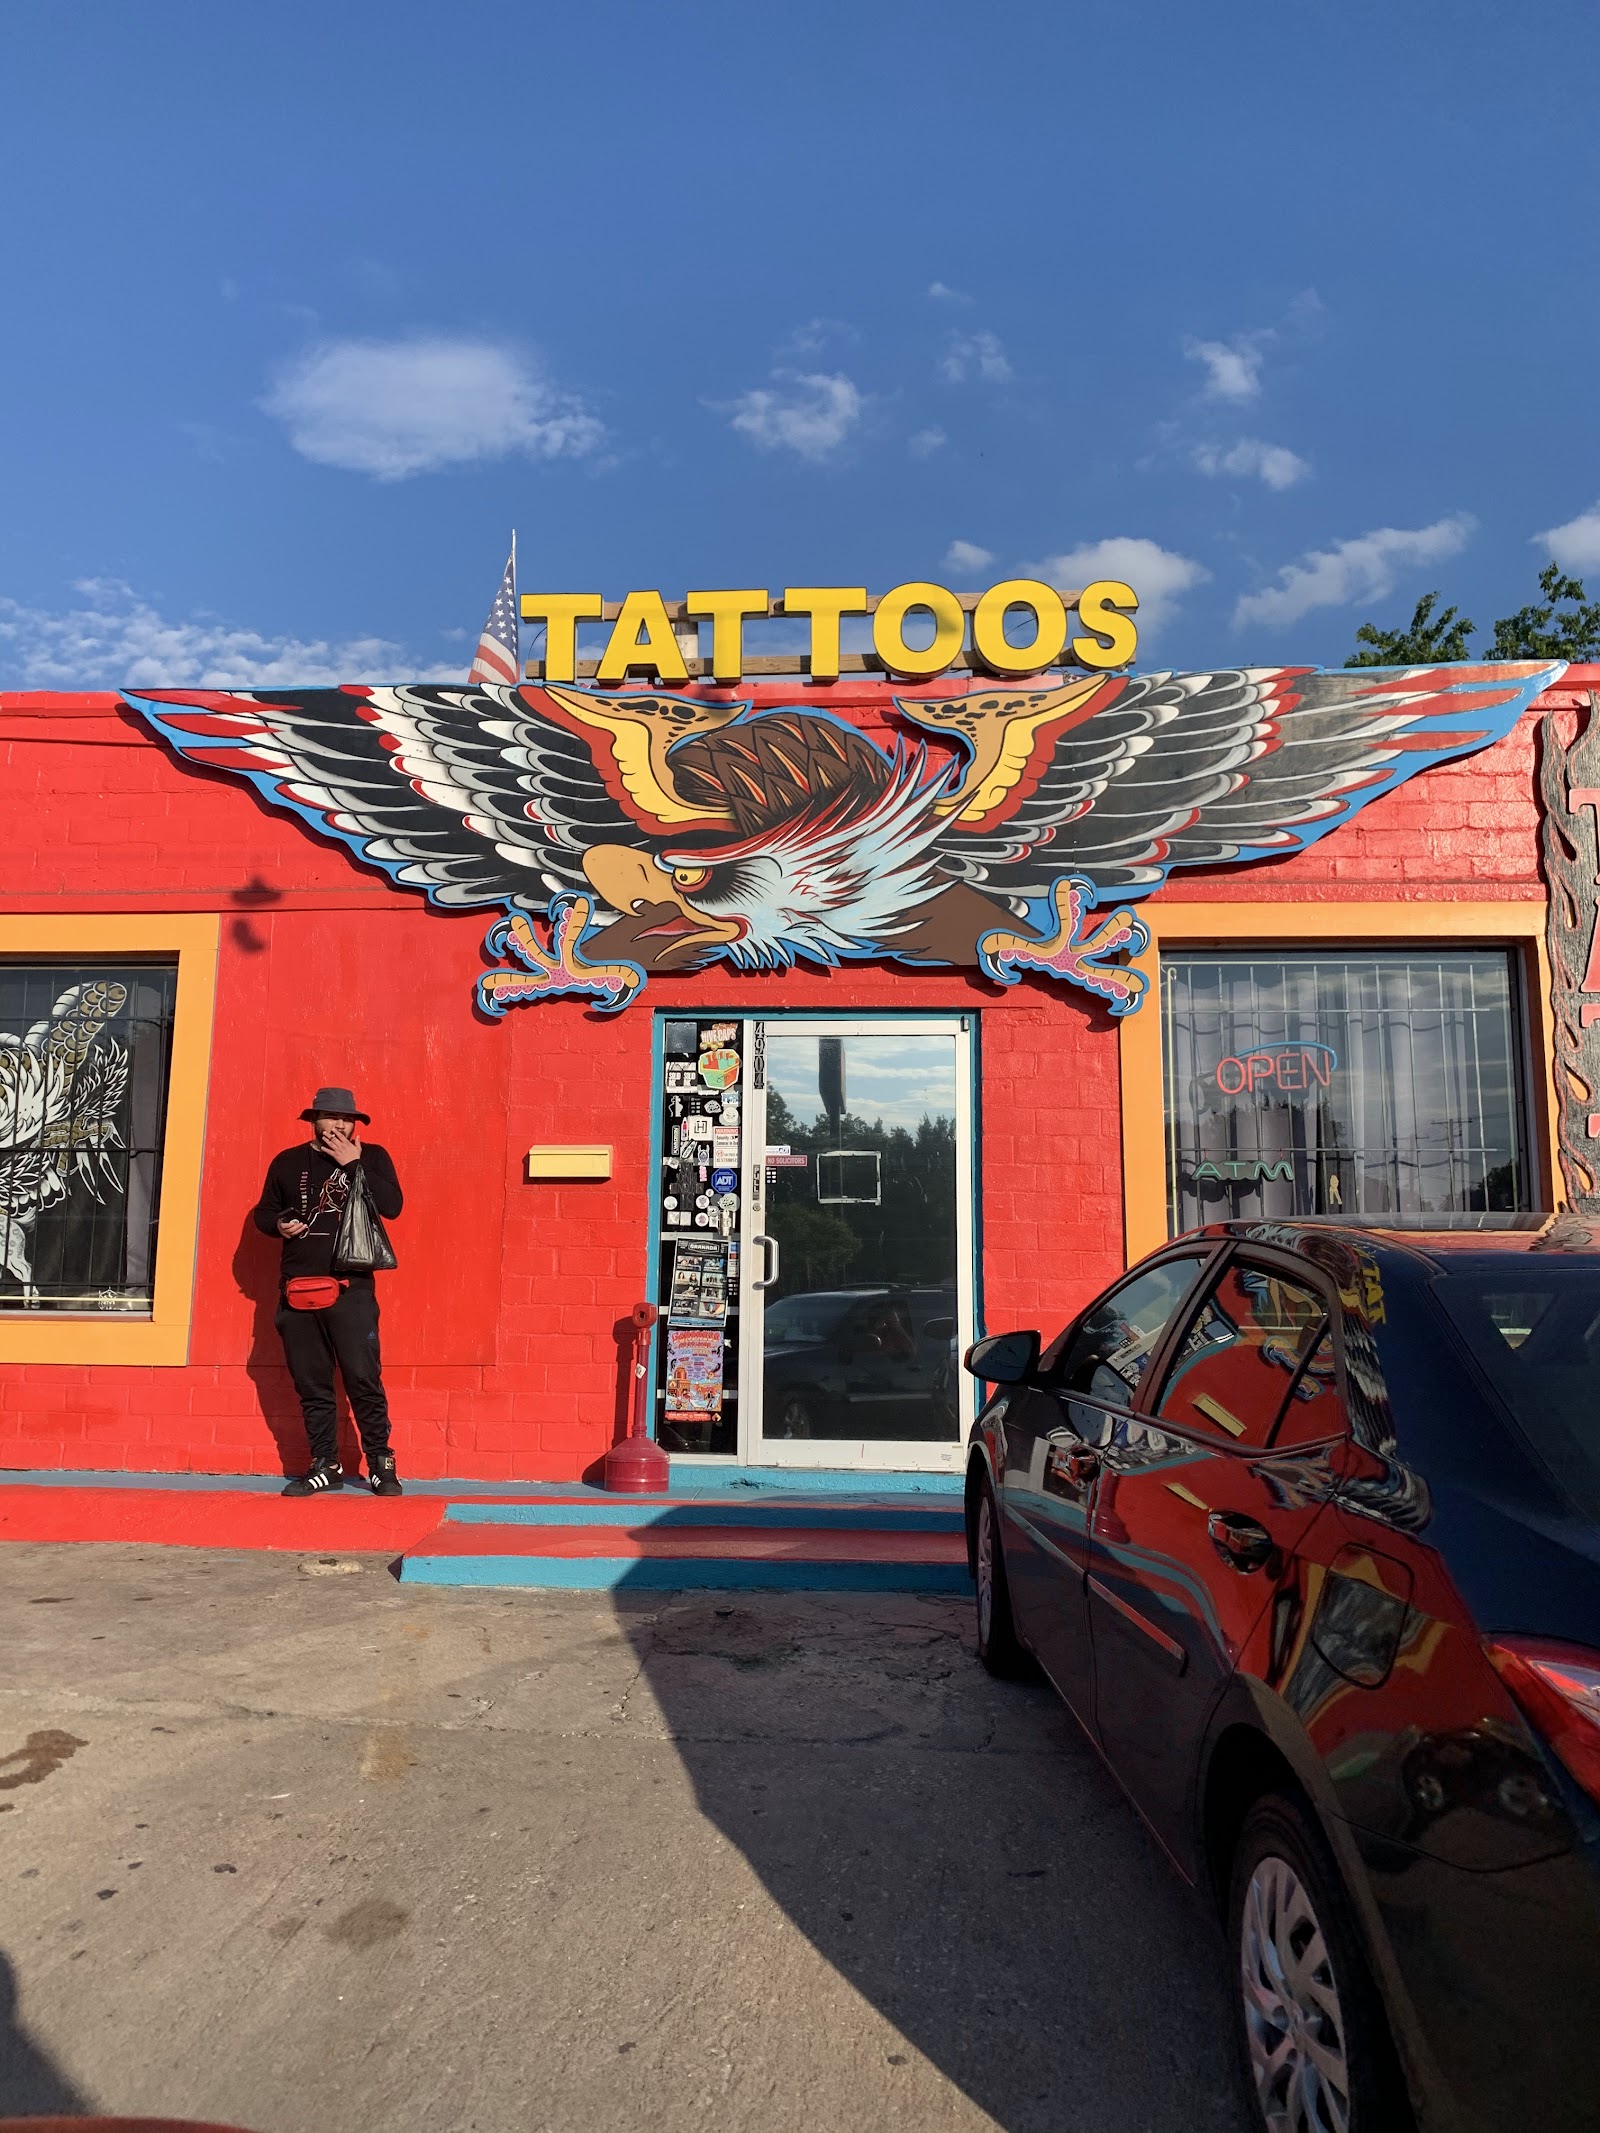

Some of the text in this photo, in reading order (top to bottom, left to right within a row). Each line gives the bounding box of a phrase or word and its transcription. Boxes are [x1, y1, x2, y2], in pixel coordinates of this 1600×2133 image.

[521, 579, 1138, 684] TATTOOS
[754, 1022, 765, 1089] 4904
[1216, 1052, 1331, 1095] OPEN
[716, 1176, 733, 1185] ADT
[1195, 1162, 1295, 1181] ATM
